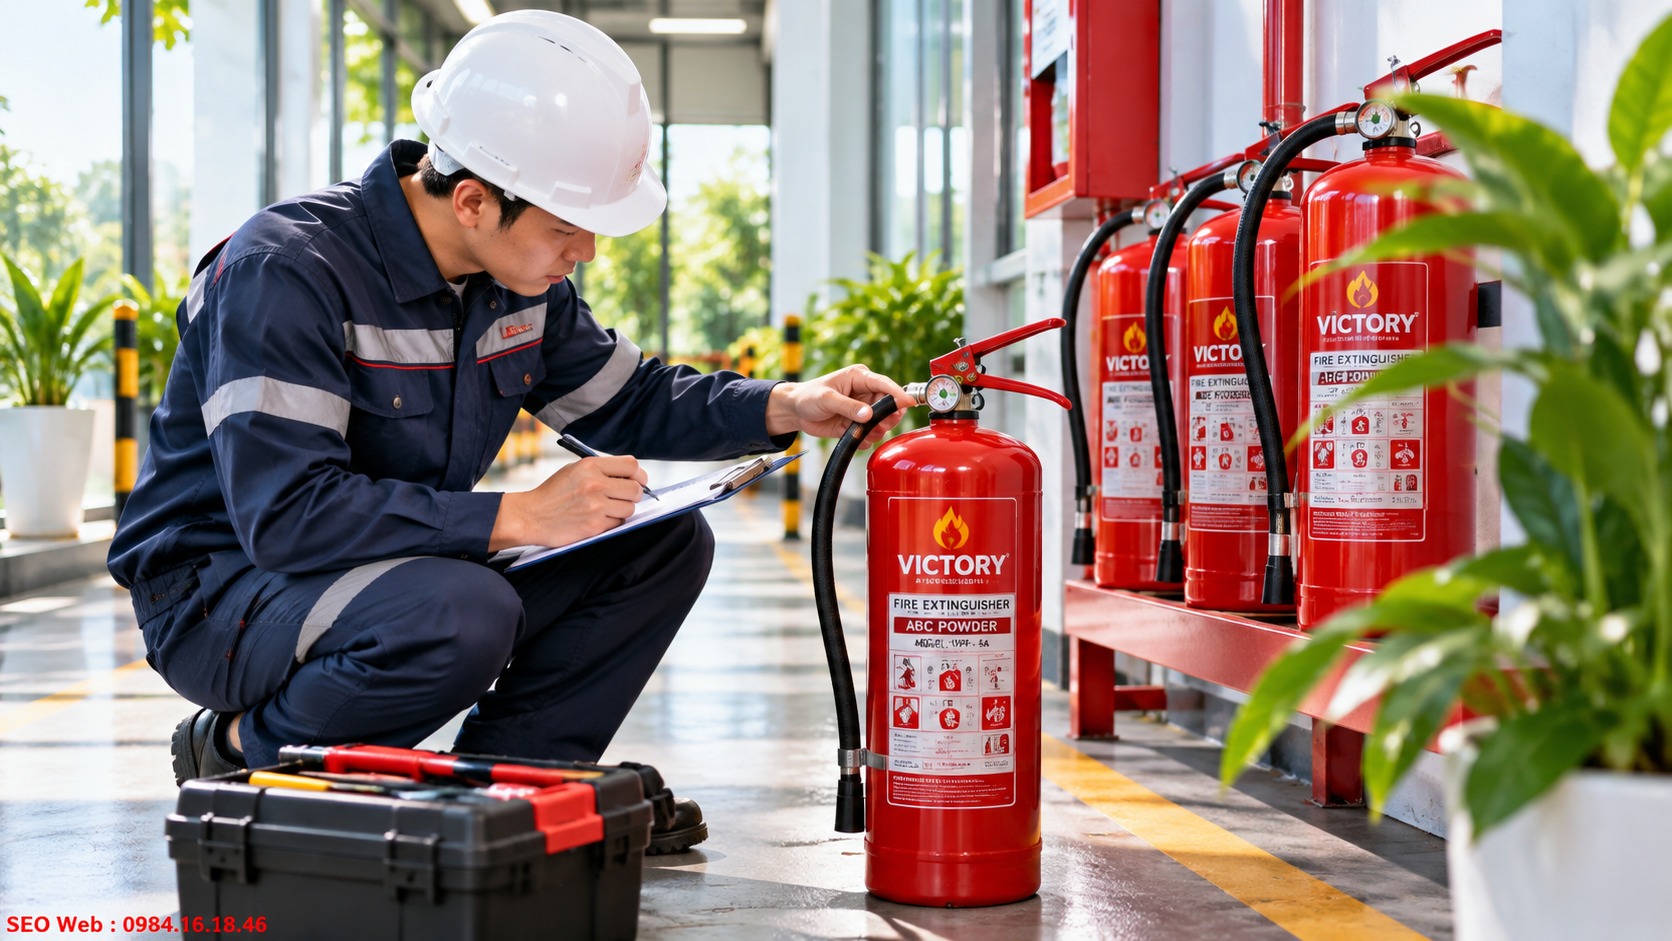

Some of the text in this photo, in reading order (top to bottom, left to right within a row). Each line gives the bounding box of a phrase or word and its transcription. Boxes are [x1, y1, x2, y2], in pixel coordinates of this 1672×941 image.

[1316, 313, 1415, 335] VICTORY
[1194, 344, 1266, 362] VICTO
[1314, 353, 1414, 365] FIRE EXTINGUISHE
[1106, 354, 1171, 372] VICTO
[897, 554, 1005, 576] VICTORY
[894, 599, 1010, 611] FIRE EXTINGUISHER
[906, 620, 998, 632] ABC POWDER
